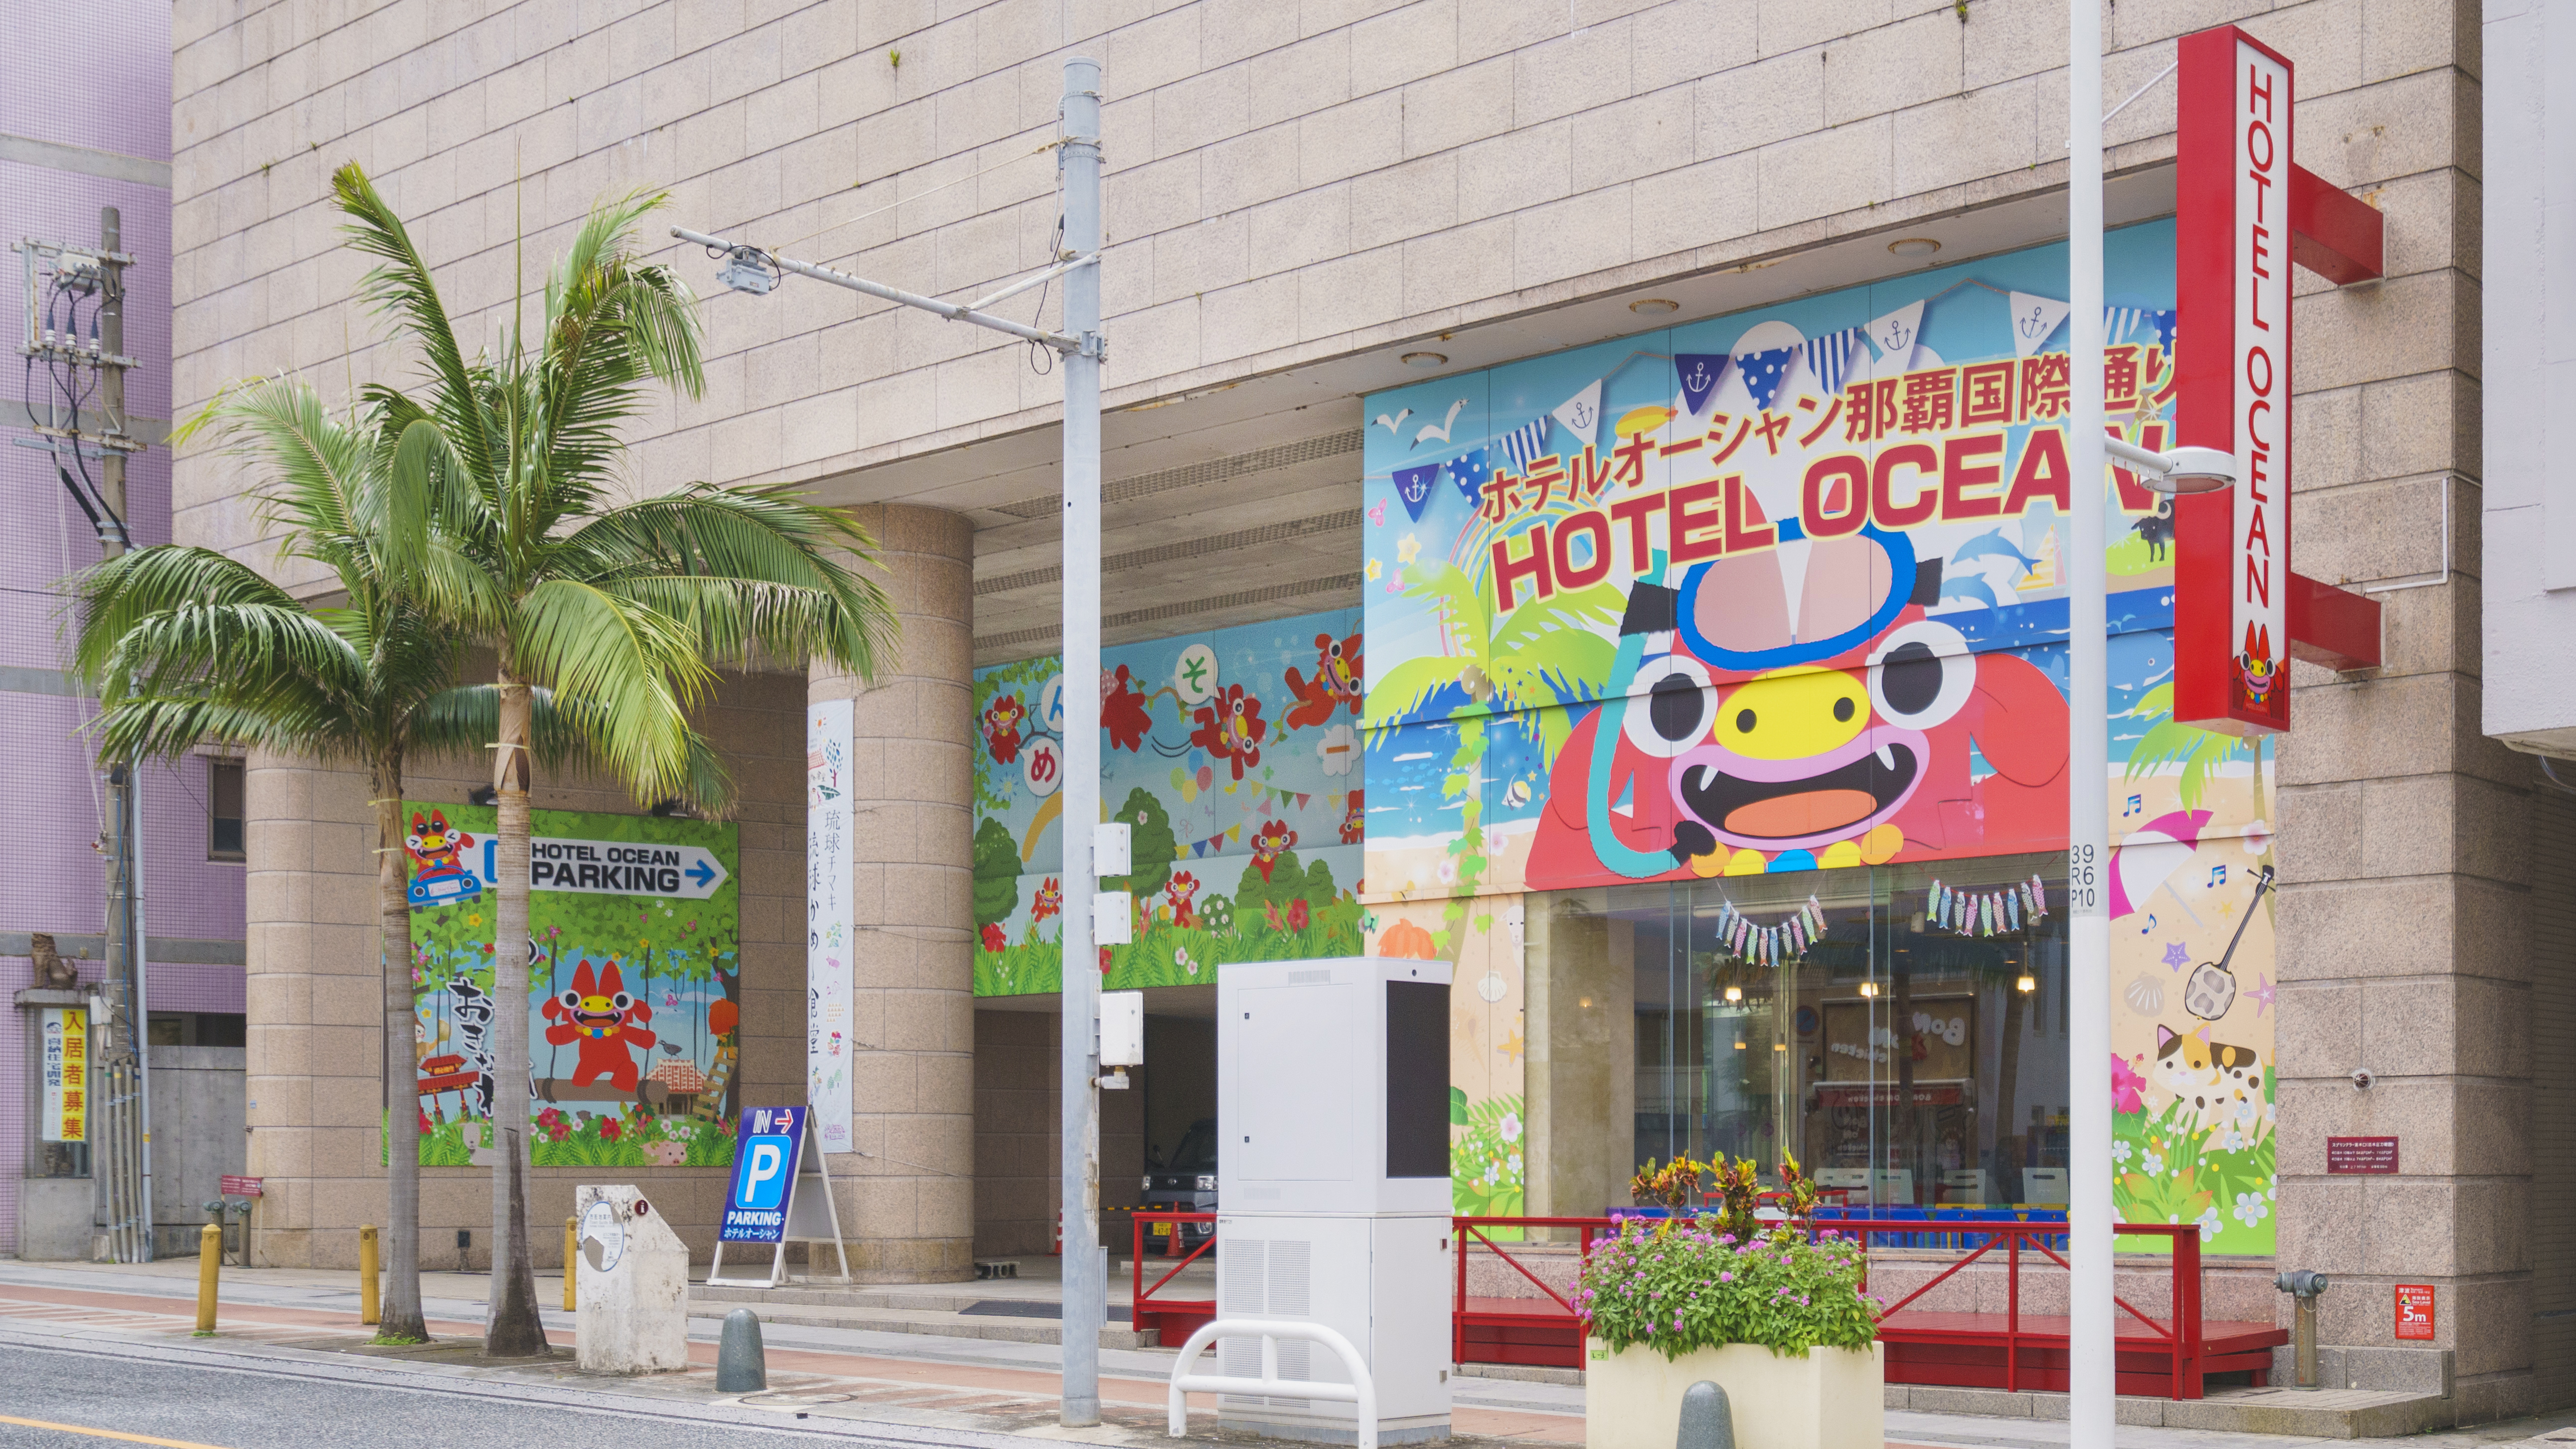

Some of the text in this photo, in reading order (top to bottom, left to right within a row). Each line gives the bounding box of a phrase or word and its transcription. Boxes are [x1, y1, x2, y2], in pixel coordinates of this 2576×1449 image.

[2247, 64, 2273, 608] HOTEL OCEAN
[1494, 424, 2167, 614] HOTEL OCEAN
[1183, 656, 1208, 694] そ
[1031, 747, 1056, 783] め
[532, 843, 680, 866] HOTEL OCEAN
[2072, 844, 2094, 864] 39
[532, 861, 680, 893] PARKING
[2072, 866, 2094, 885] R6
[2072, 888, 2095, 908] P10
[63, 1011, 84, 1139] 入居者募集
[753, 1110, 772, 1134] IN
[745, 1145, 781, 1202] P
[727, 1211, 782, 1226] PARKING
[724, 1226, 780, 1240] ホテルオーシャン
[2403, 1305, 2426, 1322] 5m
